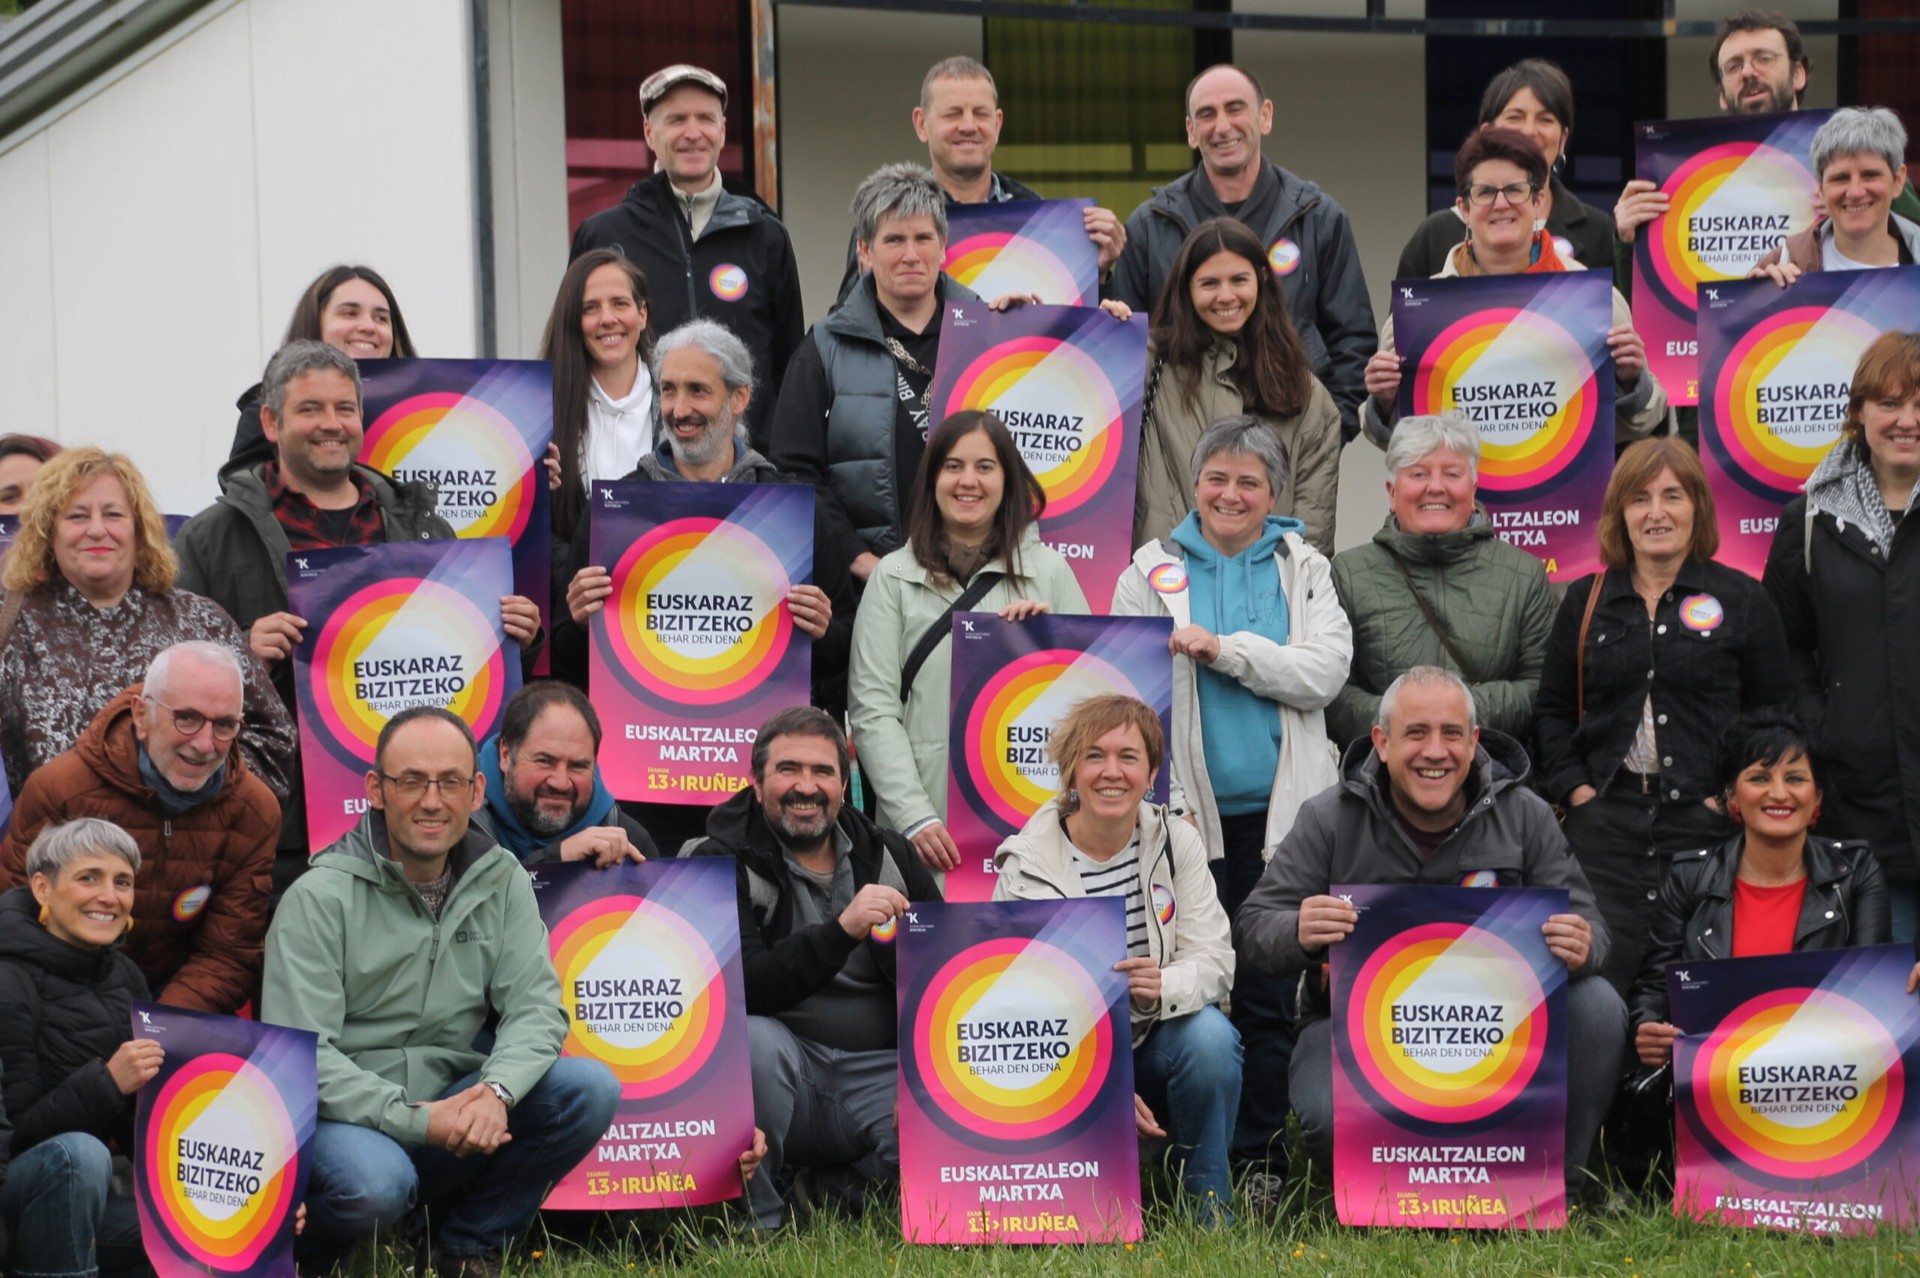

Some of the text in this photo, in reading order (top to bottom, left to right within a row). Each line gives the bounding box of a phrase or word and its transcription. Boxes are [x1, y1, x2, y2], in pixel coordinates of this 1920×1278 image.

[1688, 215, 1790, 232] EUSKARAZ
[1688, 234, 1787, 252] BIZITZEKO
[1698, 254, 1728, 263] BEHAR
[1731, 253, 1751, 262] DEN
[1452, 381, 1556, 402] EUSKARAZ
[1756, 382, 1850, 403] EUSKARA
[986, 408, 1083, 432] USKARAZ
[1757, 403, 1848, 424] BIZITZEK
[1478, 420, 1549, 432] HAR DEN DENA
[1768, 426, 1801, 435] BEHAR
[1804, 424, 1825, 433] DEN
[1012, 431, 1082, 452] ITZEKO
[1024, 451, 1071, 463] DEN DENA
[438, 509, 487, 518] DEN DENA
[1493, 509, 1579, 527] LTZALEON
[1499, 529, 1547, 546] RTXA
[647, 594, 753, 612] EUSKARAZ
[646, 615, 753, 632] BIZITZEKO
[656, 633, 743, 645] BEHAR DEN DENA
[354, 655, 463, 678] EUSKARAZ
[355, 676, 465, 699] BIZITZEKO
[367, 697, 457, 711] BEHAR DEN DENA
[625, 724, 758, 744] EUSKALTZALEO
[659, 745, 738, 763] MARTXA
[1016, 766, 1049, 776] BEHAR
[574, 979, 682, 998] EUSKARAZ
[575, 1001, 683, 1021] BIZITZEKO
[1391, 1005, 1504, 1022] EUSKARAZ
[587, 1022, 675, 1033] BEHAR DEN DENA
[957, 1019, 1068, 1041] EUSKARAZ
[1391, 1027, 1504, 1044] BIZITZEKO
[957, 1041, 1070, 1063] BIZITZEKO
[1403, 1047, 1494, 1057] BEHAR DEN DENA
[969, 1062, 1061, 1075] BEHAR DEN DENA
[1738, 1064, 1858, 1084] EUSKARAZ
[1739, 1085, 1858, 1105] BIZITZEKO
[1751, 1103, 1848, 1114] BEHAR DEN DENA
[603, 1119, 716, 1140] ALTZALEON
[178, 1138, 264, 1171] EUSKARAZ
[598, 1142, 681, 1162] MARTXA
[1372, 1146, 1525, 1163] EUSKALTZALEON
[177, 1162, 260, 1195] BIZITZEKO
[940, 1161, 1099, 1183] EUSKALTZALEON
[1408, 1166, 1490, 1184] MARTXA
[183, 1186, 249, 1208] BEHAR DEN DENA
[979, 1183, 1064, 1203] MARTXA
